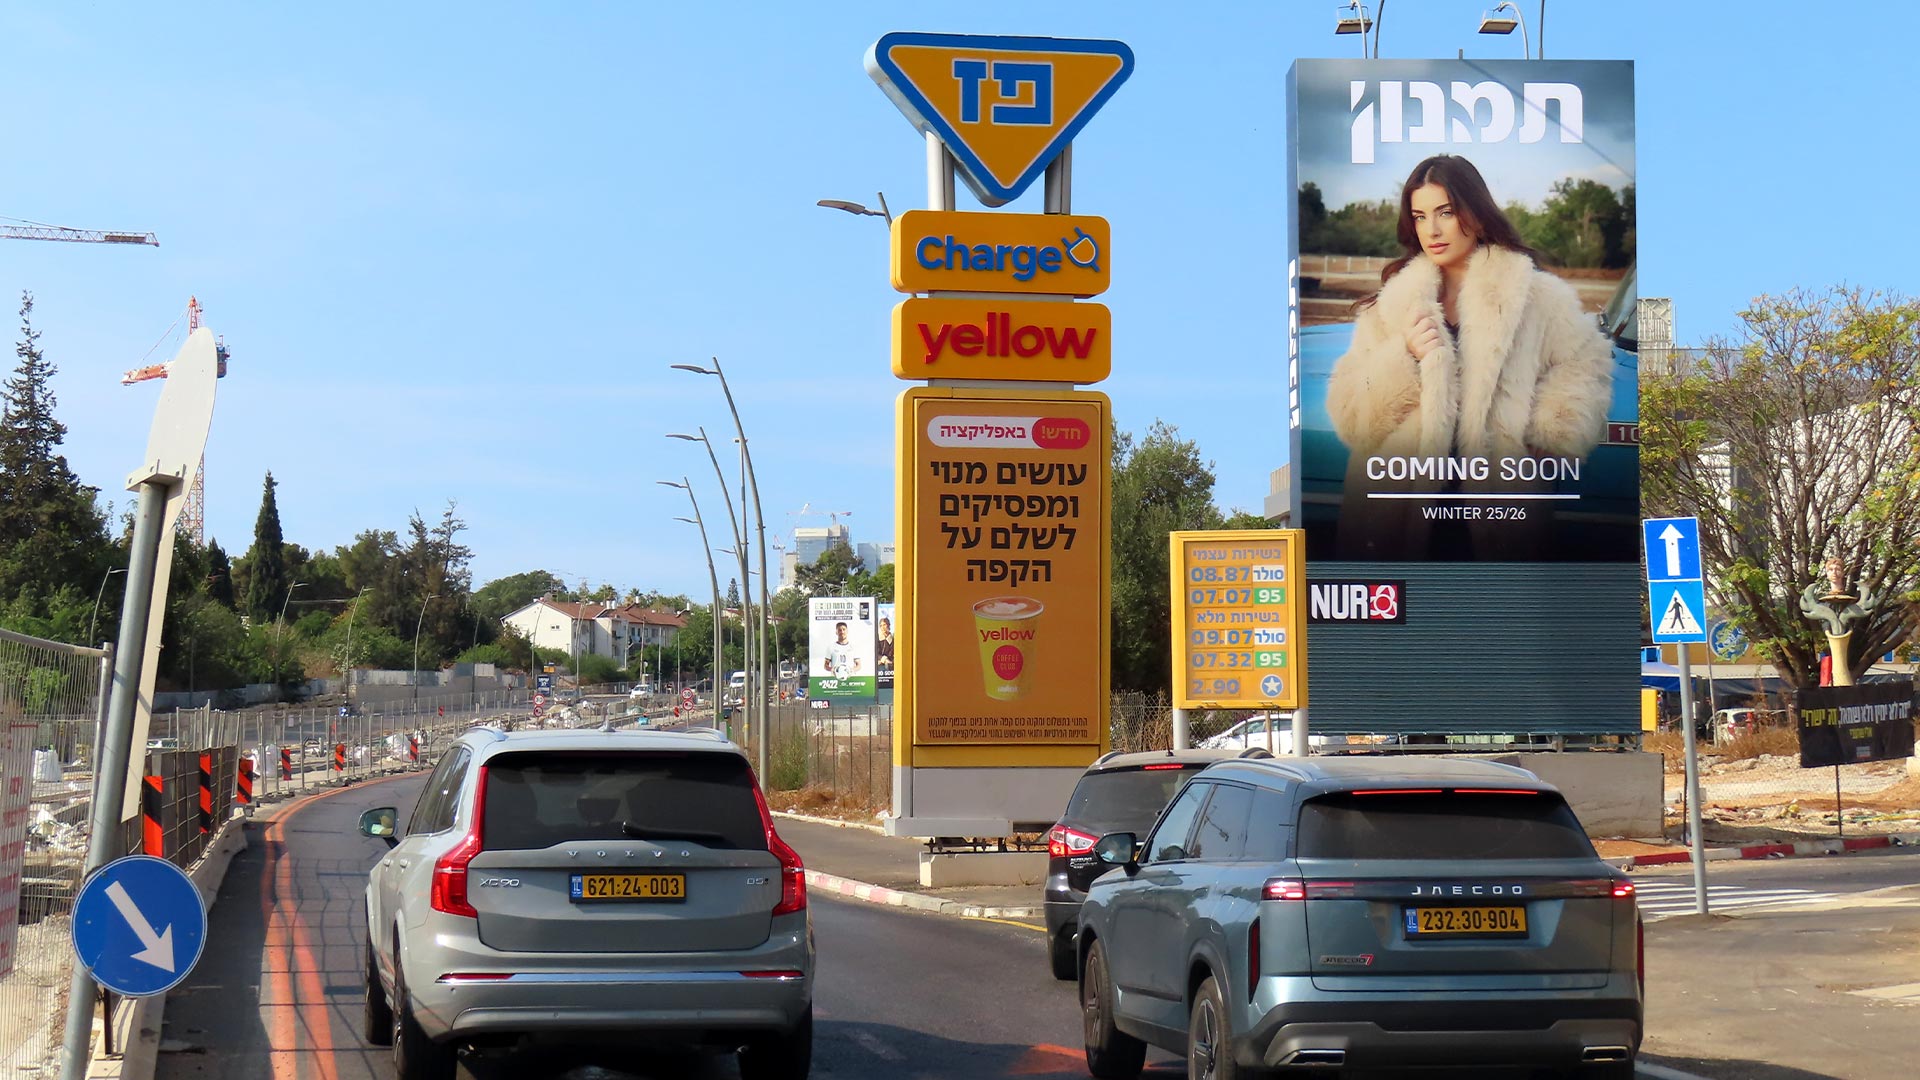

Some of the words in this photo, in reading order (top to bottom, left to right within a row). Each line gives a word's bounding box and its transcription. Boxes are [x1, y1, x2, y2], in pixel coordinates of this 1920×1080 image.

[952, 58, 1054, 126] פז
[1350, 80, 1584, 164] תמנון
[916, 234, 1063, 281] Charge
[918, 312, 1097, 364] yellow
[940, 424, 1026, 441] באפליקציה
[1041, 425, 1081, 440] חדש!
[931, 461, 988, 484] מנוי
[997, 462, 1087, 485] עושים
[1366, 456, 1490, 481] COMING
[1500, 456, 1580, 481] SOON
[939, 494, 1079, 522] ומפסיקים
[1422, 506, 1481, 520] WINTER
[1486, 506, 1527, 521] 25/26
[942, 522, 981, 549] על
[990, 523, 1076, 550] לשלם
[1193, 549, 1227, 560] עצמי
[1232, 548, 1281, 560] בשירות
[967, 559, 1051, 587] הקפה
[1190, 567, 1251, 582] 08.87
[1254, 566, 1284, 581] סולר
[1191, 589, 1251, 604] 07.07
[1258, 590, 1281, 603] 95
[1311, 584, 1369, 620] NUR
[1196, 610, 1225, 623] מלא
[1230, 612, 1280, 623] בשירות
[980, 627, 1035, 642] yellow
[1191, 630, 1253, 645] 09.07
[1255, 629, 1285, 643] סולר
[996, 654, 1019, 662] COFFEE
[1192, 652, 1251, 668] 07.32
[1259, 653, 1282, 667] 95
[1192, 678, 1240, 694] 2.90
[928, 729, 951, 738] YELLOW
[567, 849, 690, 859] VOLVO
[480, 878, 520, 887] XC90
[1411, 885, 1522, 896] JAECOO
